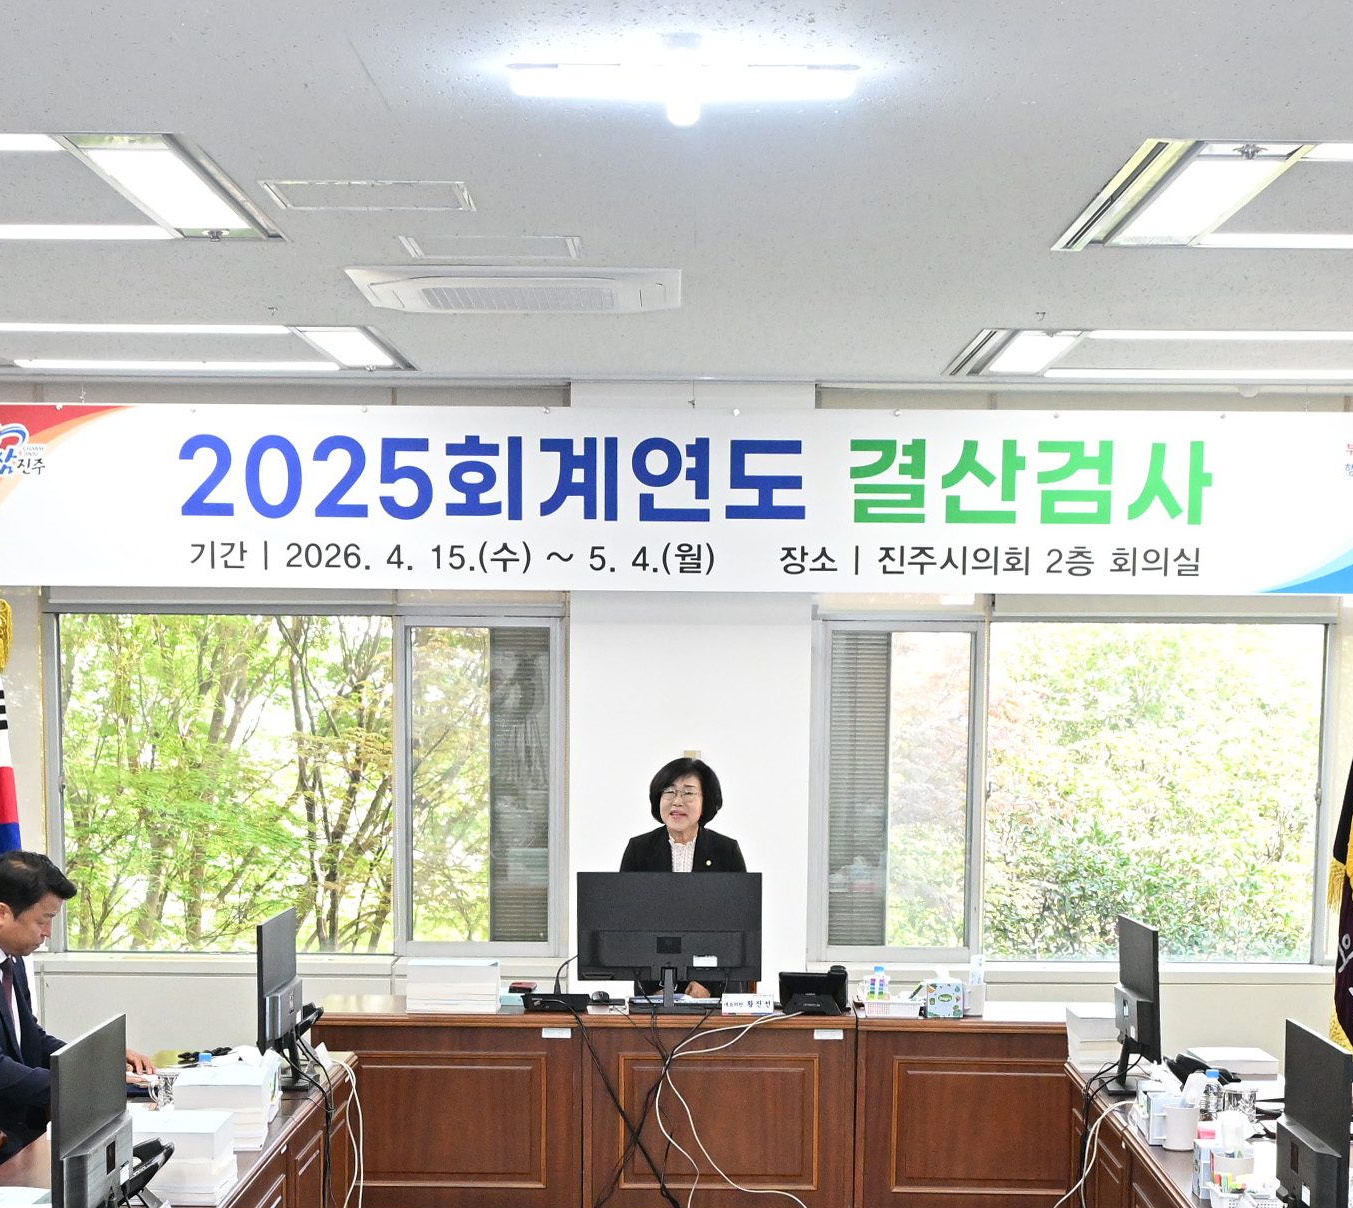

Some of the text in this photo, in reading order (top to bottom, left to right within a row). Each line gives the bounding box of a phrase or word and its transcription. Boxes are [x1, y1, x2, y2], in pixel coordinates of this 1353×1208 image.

[17, 458, 46, 475] 진주
[179, 434, 1213, 526] 2025회계연도 결산검사
[190, 540, 248, 570] 기간
[286, 542, 371, 571] 2026.
[386, 544, 413, 571] 4.
[431, 540, 531, 574] 15.(수)
[589, 545, 616, 573] 5.
[631, 542, 715, 576] 4.(월)
[779, 545, 838, 575] 장소
[877, 545, 1030, 576] 진주시의회
[1046, 546, 1095, 577] 2층
[1109, 547, 1201, 578] 회의실
